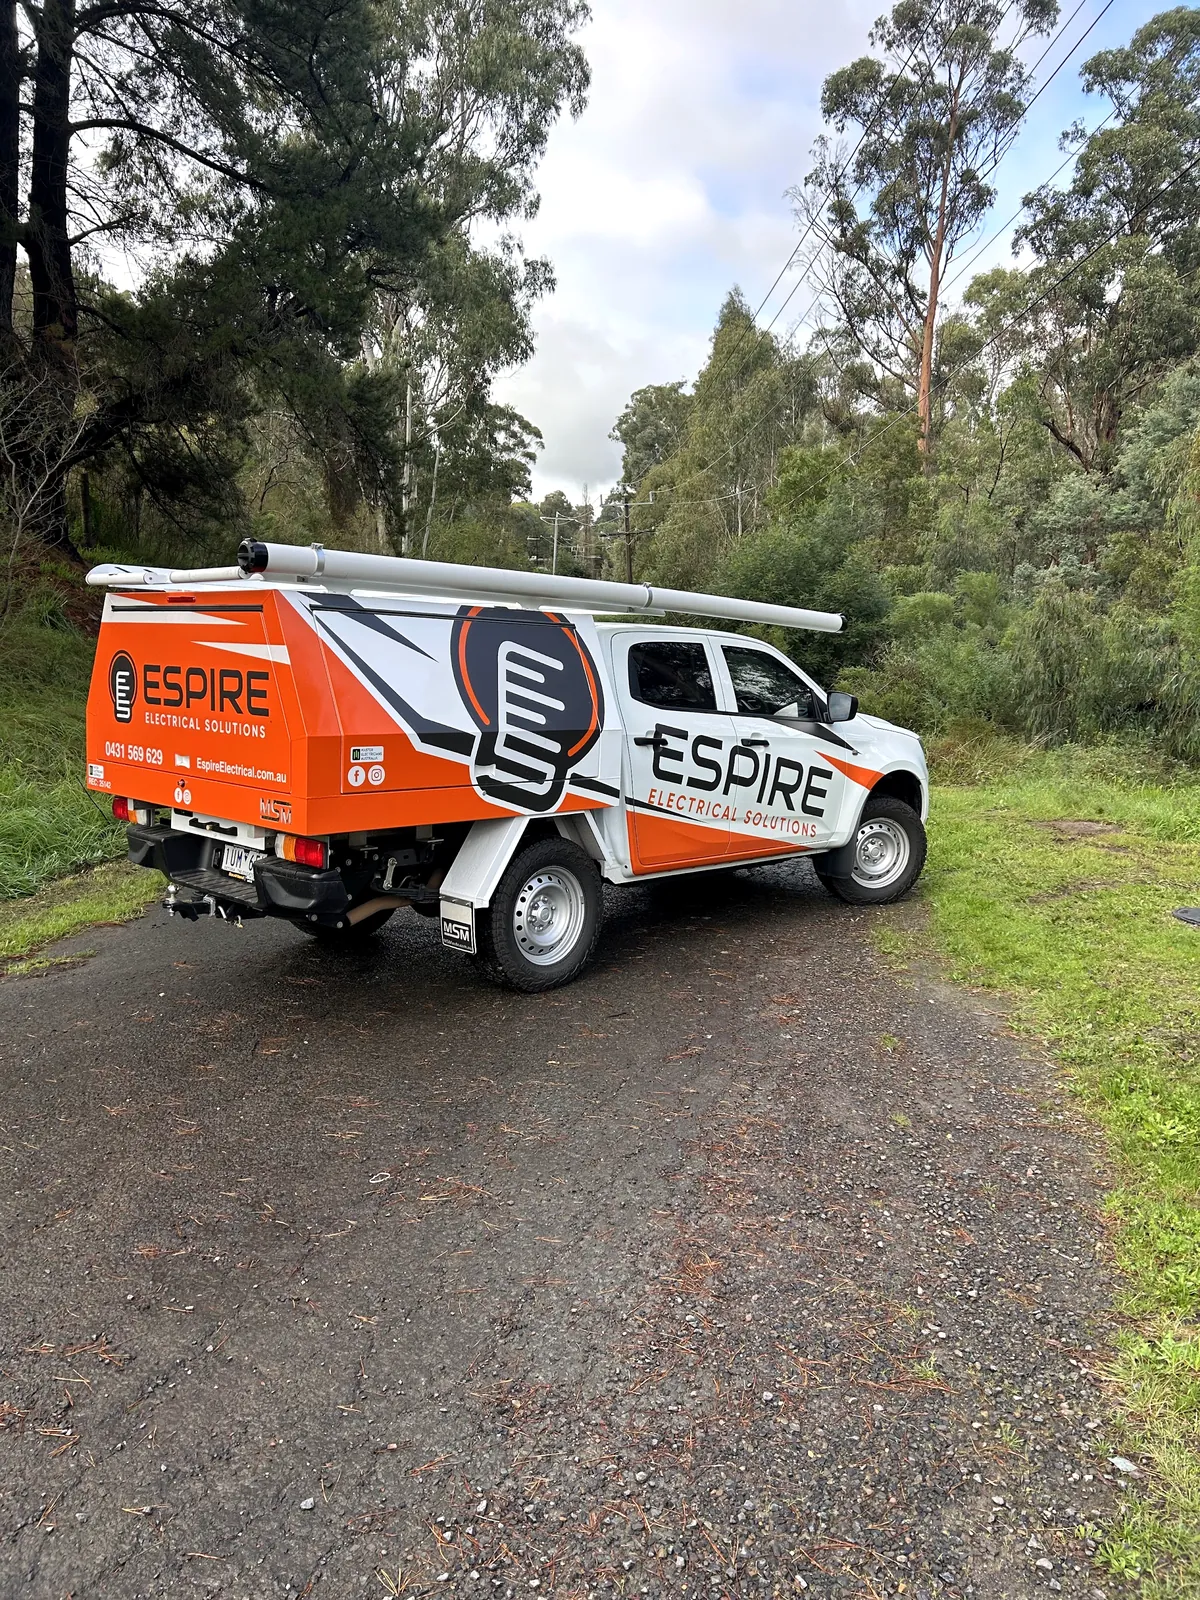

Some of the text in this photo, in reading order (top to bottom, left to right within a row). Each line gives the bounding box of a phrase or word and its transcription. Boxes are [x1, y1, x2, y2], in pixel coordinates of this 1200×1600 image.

[143, 664, 270, 717] ESPIRE
[145, 712, 266, 739] ELECTRICAL SOLUTIONS
[105, 741, 163, 765] 0431 569 629
[196, 757, 287, 783] EspireElectrical.com.au
[652, 723, 833, 818] ESPIRE
[260, 797, 292, 825] MSM
[648, 788, 817, 838] ELECTRICAL SOLUTIONS
[443, 921, 470, 942] MSM
